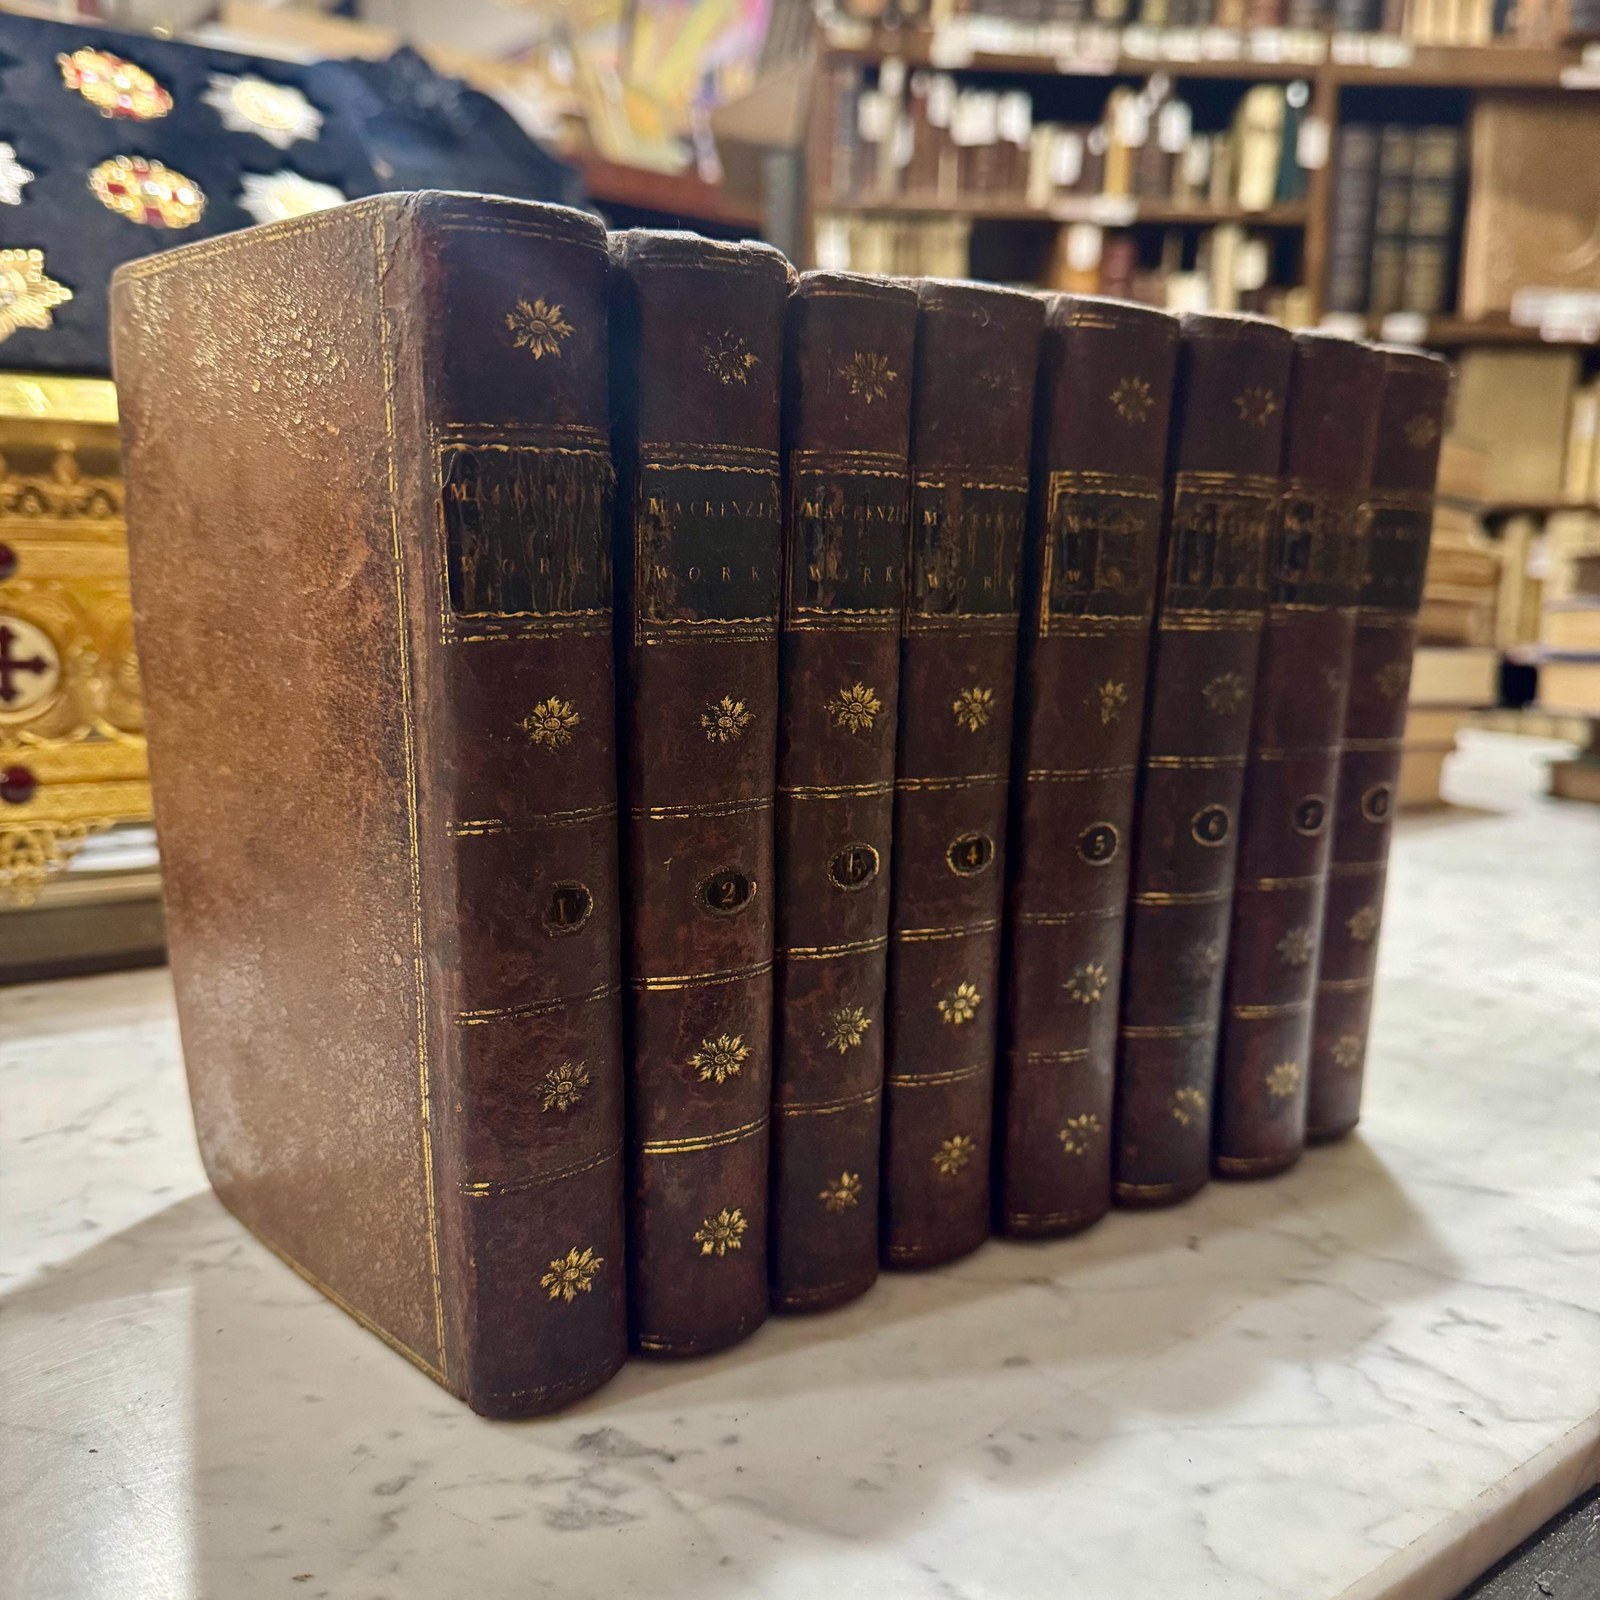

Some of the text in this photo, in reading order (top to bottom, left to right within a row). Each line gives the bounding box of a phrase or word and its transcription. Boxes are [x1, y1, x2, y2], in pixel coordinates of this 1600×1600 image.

[1208, 815, 1221, 836] 6
[966, 844, 979, 866] 4
[1093, 833, 1106, 856] 5
[721, 880, 736, 904] 2
